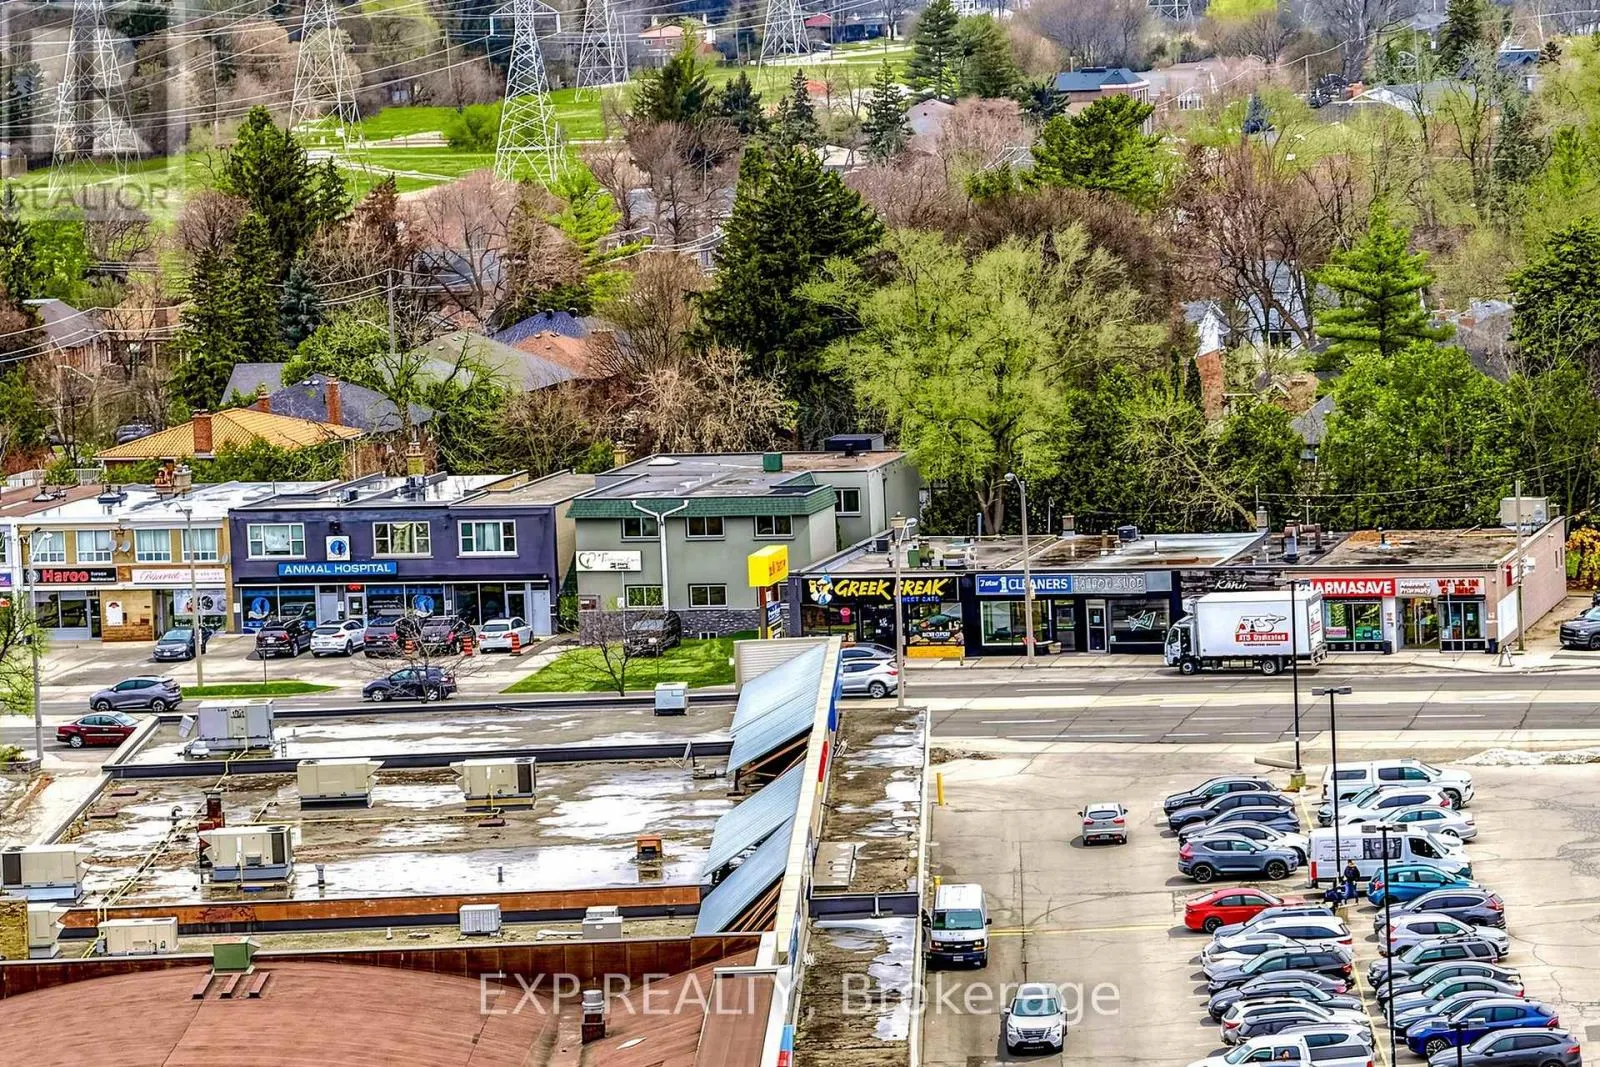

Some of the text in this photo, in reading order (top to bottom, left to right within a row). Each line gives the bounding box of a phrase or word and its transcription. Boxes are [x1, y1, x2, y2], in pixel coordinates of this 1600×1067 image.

[284, 562, 392, 574] ANIMAL HOSPITAL
[1468, 579, 1479, 587] IN
[834, 578, 950, 600] GREEK FREAK
[1441, 586, 1476, 595] CINIC
